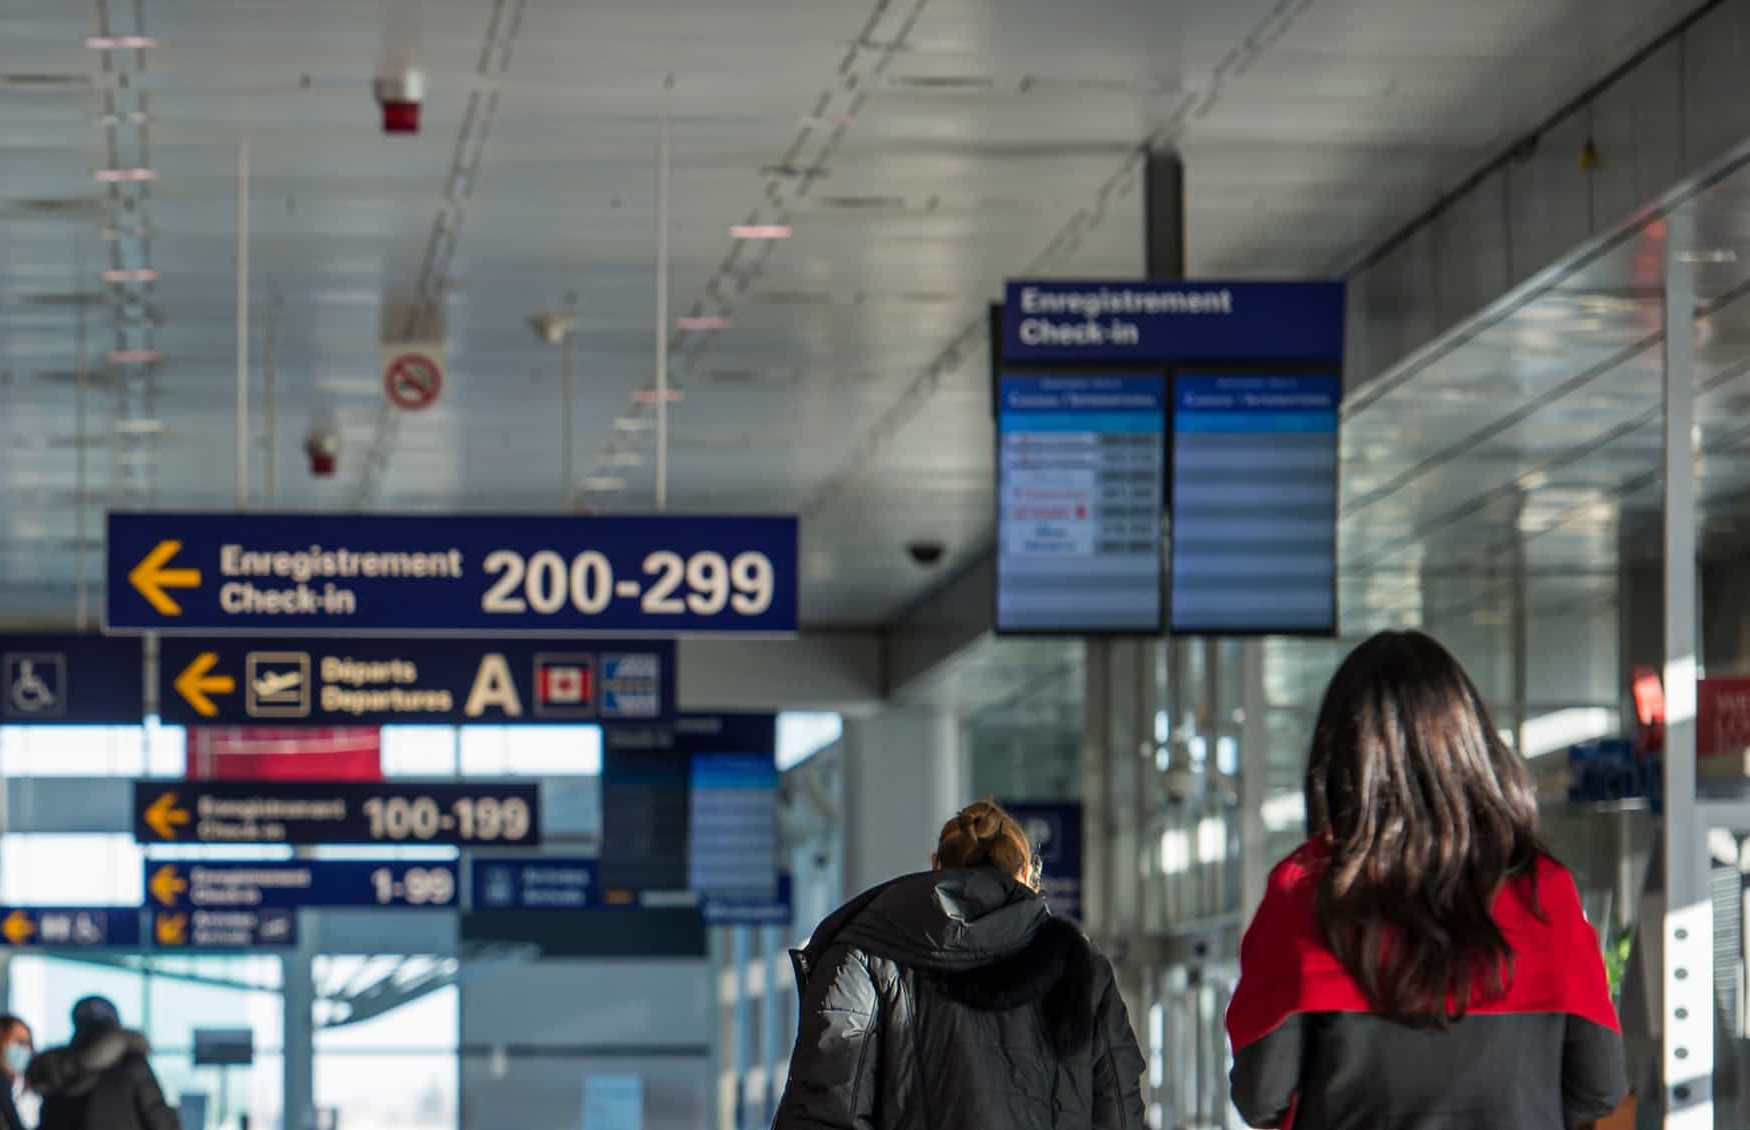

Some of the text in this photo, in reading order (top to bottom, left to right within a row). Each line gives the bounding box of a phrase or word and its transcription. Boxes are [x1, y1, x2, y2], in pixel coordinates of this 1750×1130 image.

[1019, 287, 1232, 319] Enregistrement
[1018, 318, 1140, 346] Check-in
[219, 544, 464, 582] Enregistrement
[219, 582, 356, 614] Check-in
[481, 550, 775, 616] 200-299
[320, 655, 418, 687] Départs
[464, 652, 523, 718] A
[320, 685, 453, 716] Departures
[362, 796, 531, 841] 100-199
[371, 867, 455, 905] 1-99
